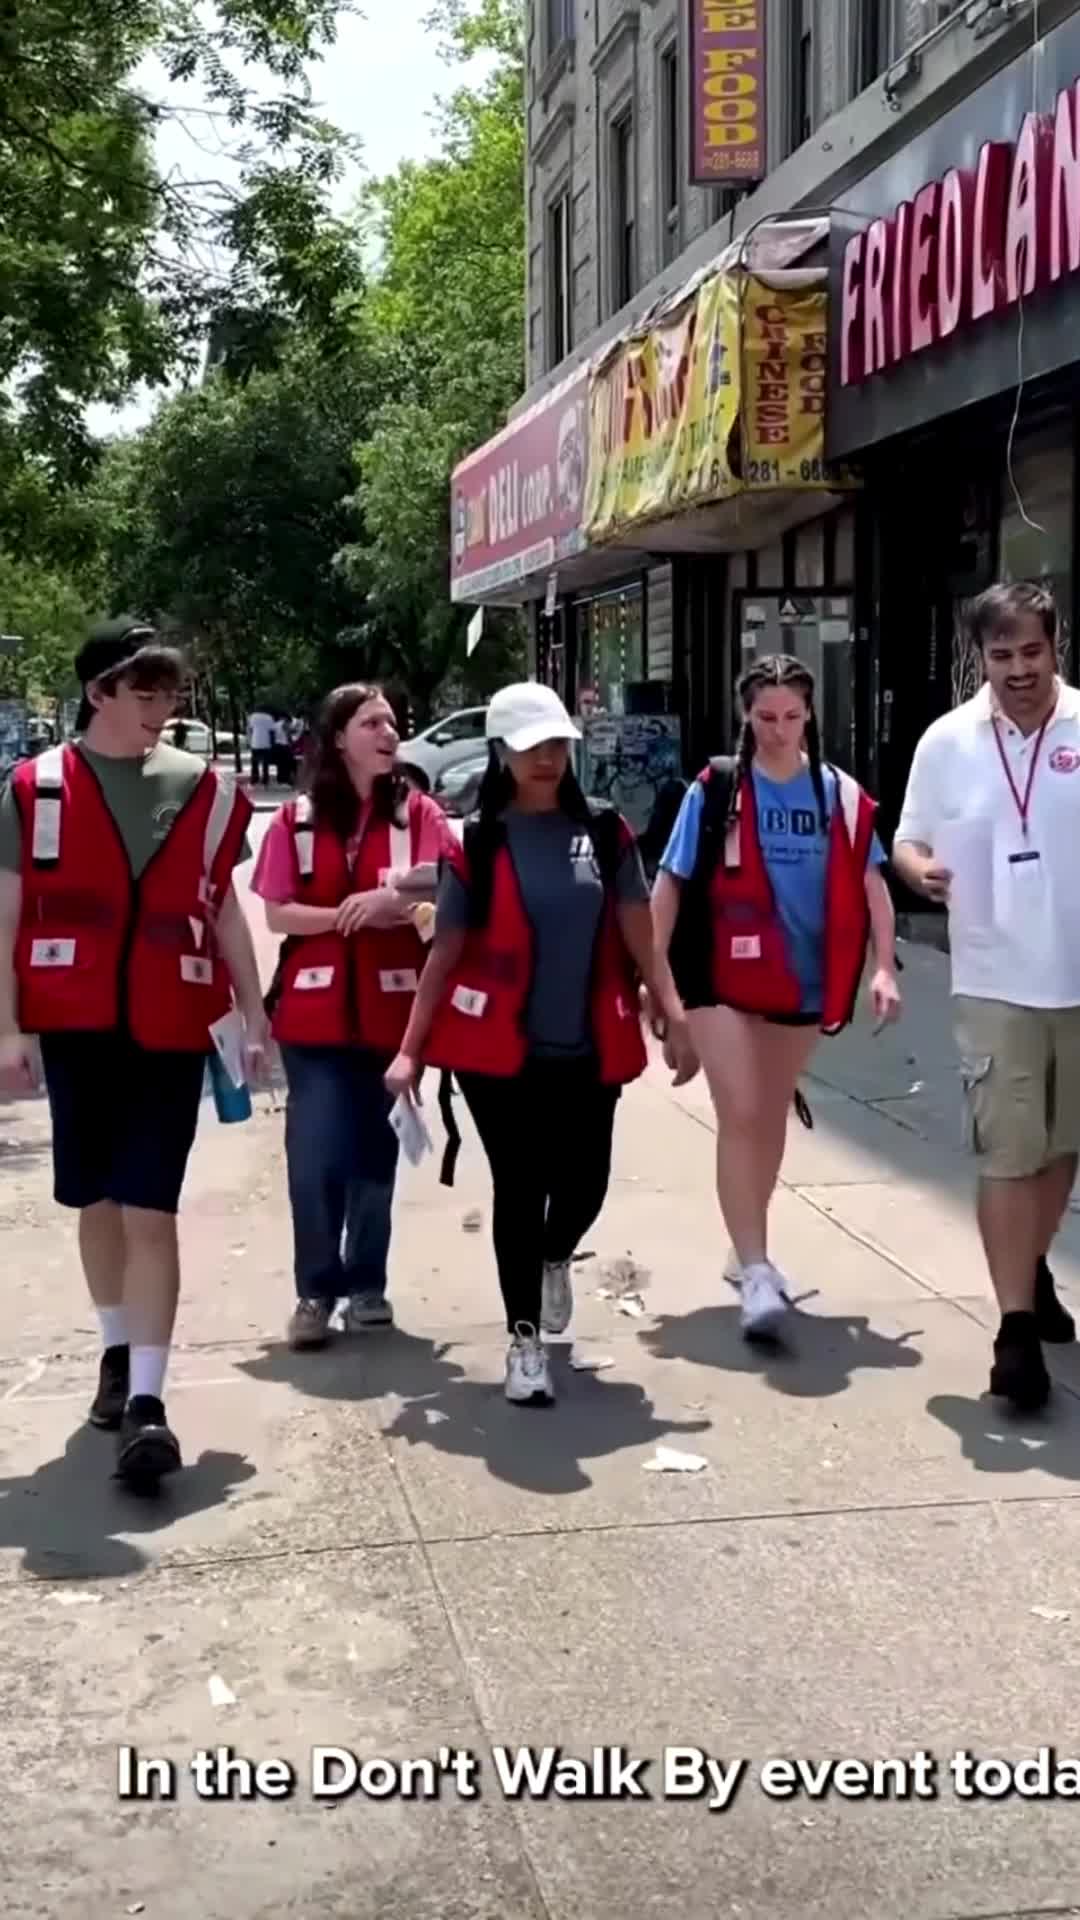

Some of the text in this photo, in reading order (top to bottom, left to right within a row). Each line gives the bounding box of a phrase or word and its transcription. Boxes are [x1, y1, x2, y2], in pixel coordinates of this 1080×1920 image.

[703, 48, 757, 147] FOOD
[755, 304, 790, 445] CHINESE
[488, 458, 519, 546] DELI
